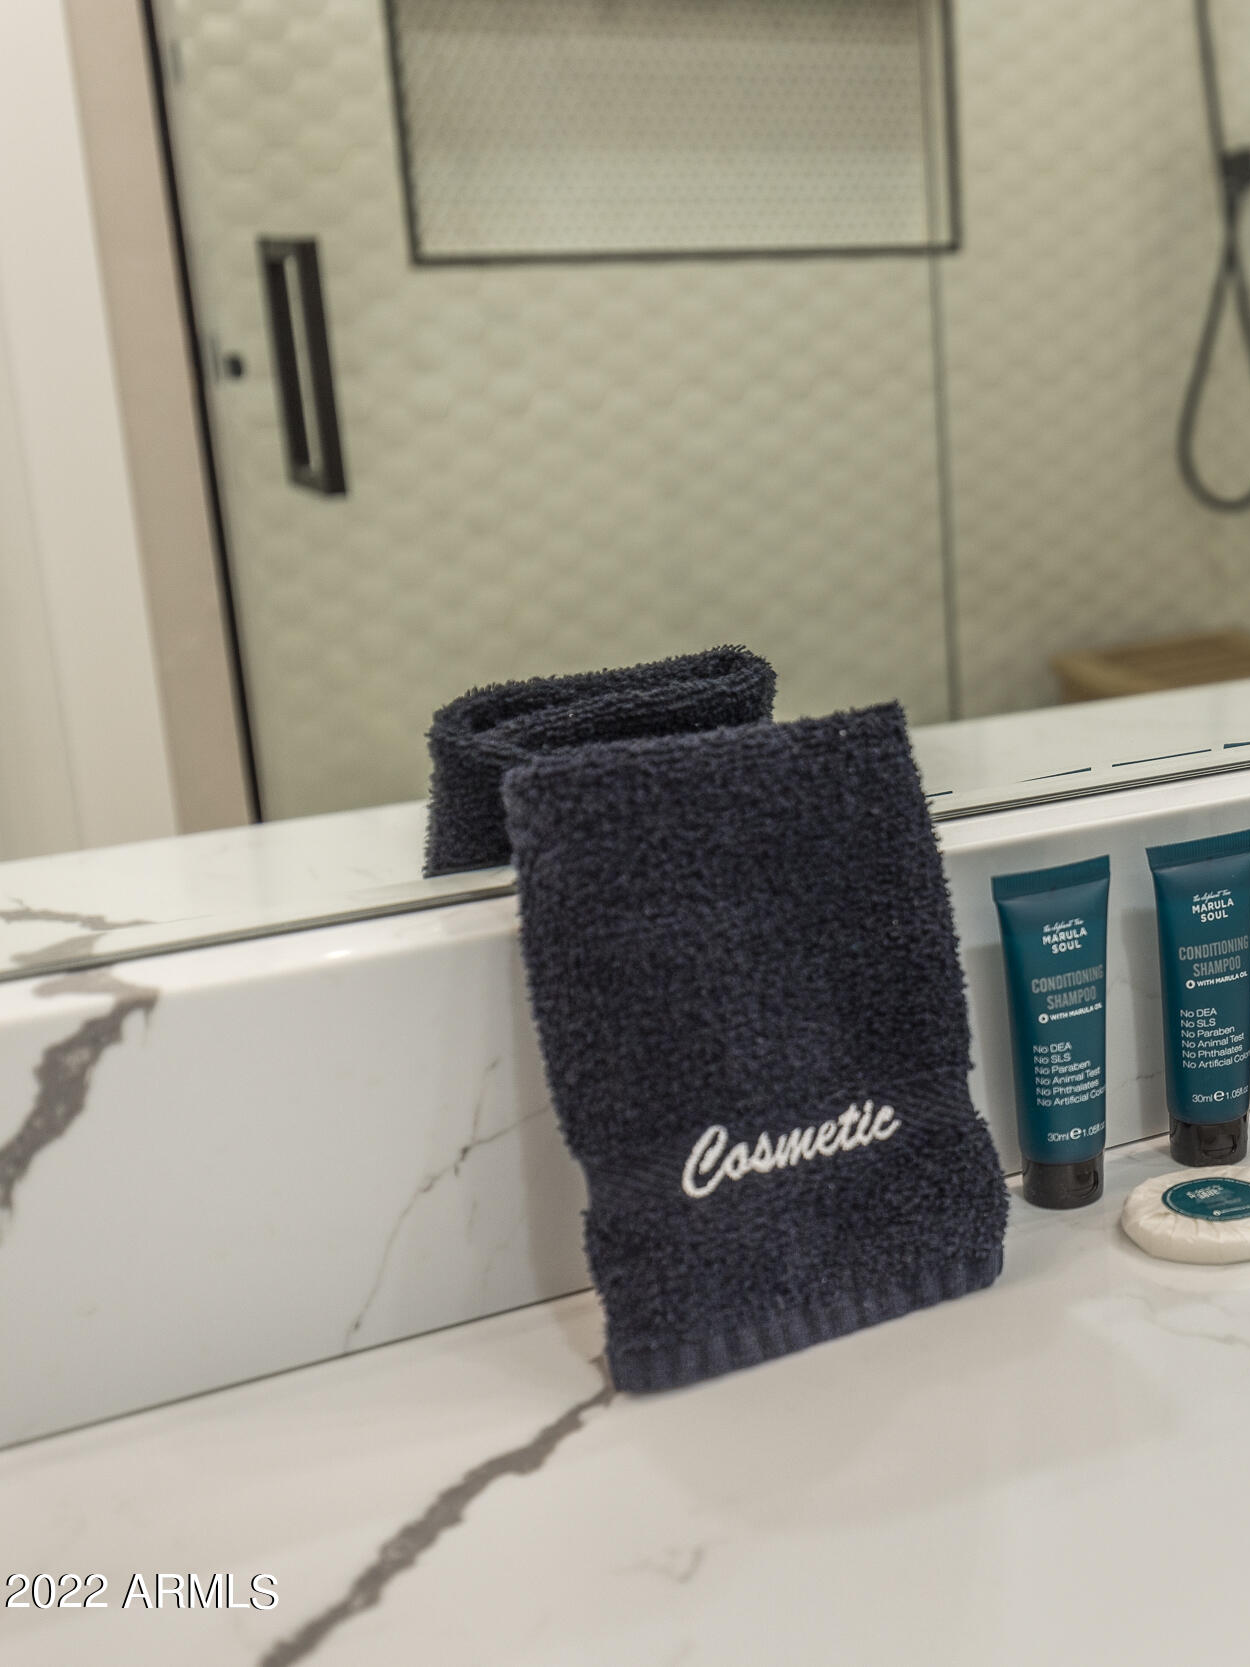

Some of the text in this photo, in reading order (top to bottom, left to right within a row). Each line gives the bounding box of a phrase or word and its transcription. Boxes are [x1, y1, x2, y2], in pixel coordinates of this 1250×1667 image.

[1192, 898, 1234, 914] MARULA
[1201, 910, 1228, 922] SOUL
[1042, 927, 1088, 945] MARULA
[1051, 940, 1082, 954] SOUL
[1179, 935, 1249, 961] CONDITIONING
[1193, 955, 1241, 977] SHAMPOO
[1031, 964, 1104, 994] CONDITIONING
[1197, 978, 1214, 987] WITH
[1047, 986, 1096, 1010] SHAMPOO
[1050, 1012, 1068, 1021] WITH
[1181, 1008, 1217, 1018] No DEA
[1181, 1018, 1216, 1028] No SLS
[1181, 1026, 1235, 1038] No Paraben
[1182, 1033, 1244, 1048] No Animal Test
[1033, 1042, 1072, 1054] No DEA
[1182, 1050, 1196, 1058] No
[1034, 1053, 1071, 1064] No SLS
[1183, 1060, 1196, 1069] No
[1035, 1060, 1091, 1075] No Paraben
[1035, 1077, 1049, 1085] No
[1052, 1072, 1084, 1084] Animal
[1036, 1088, 1051, 1096] No
[1037, 1098, 1051, 1107] No
[681, 1099, 902, 1198] Cosmetic
